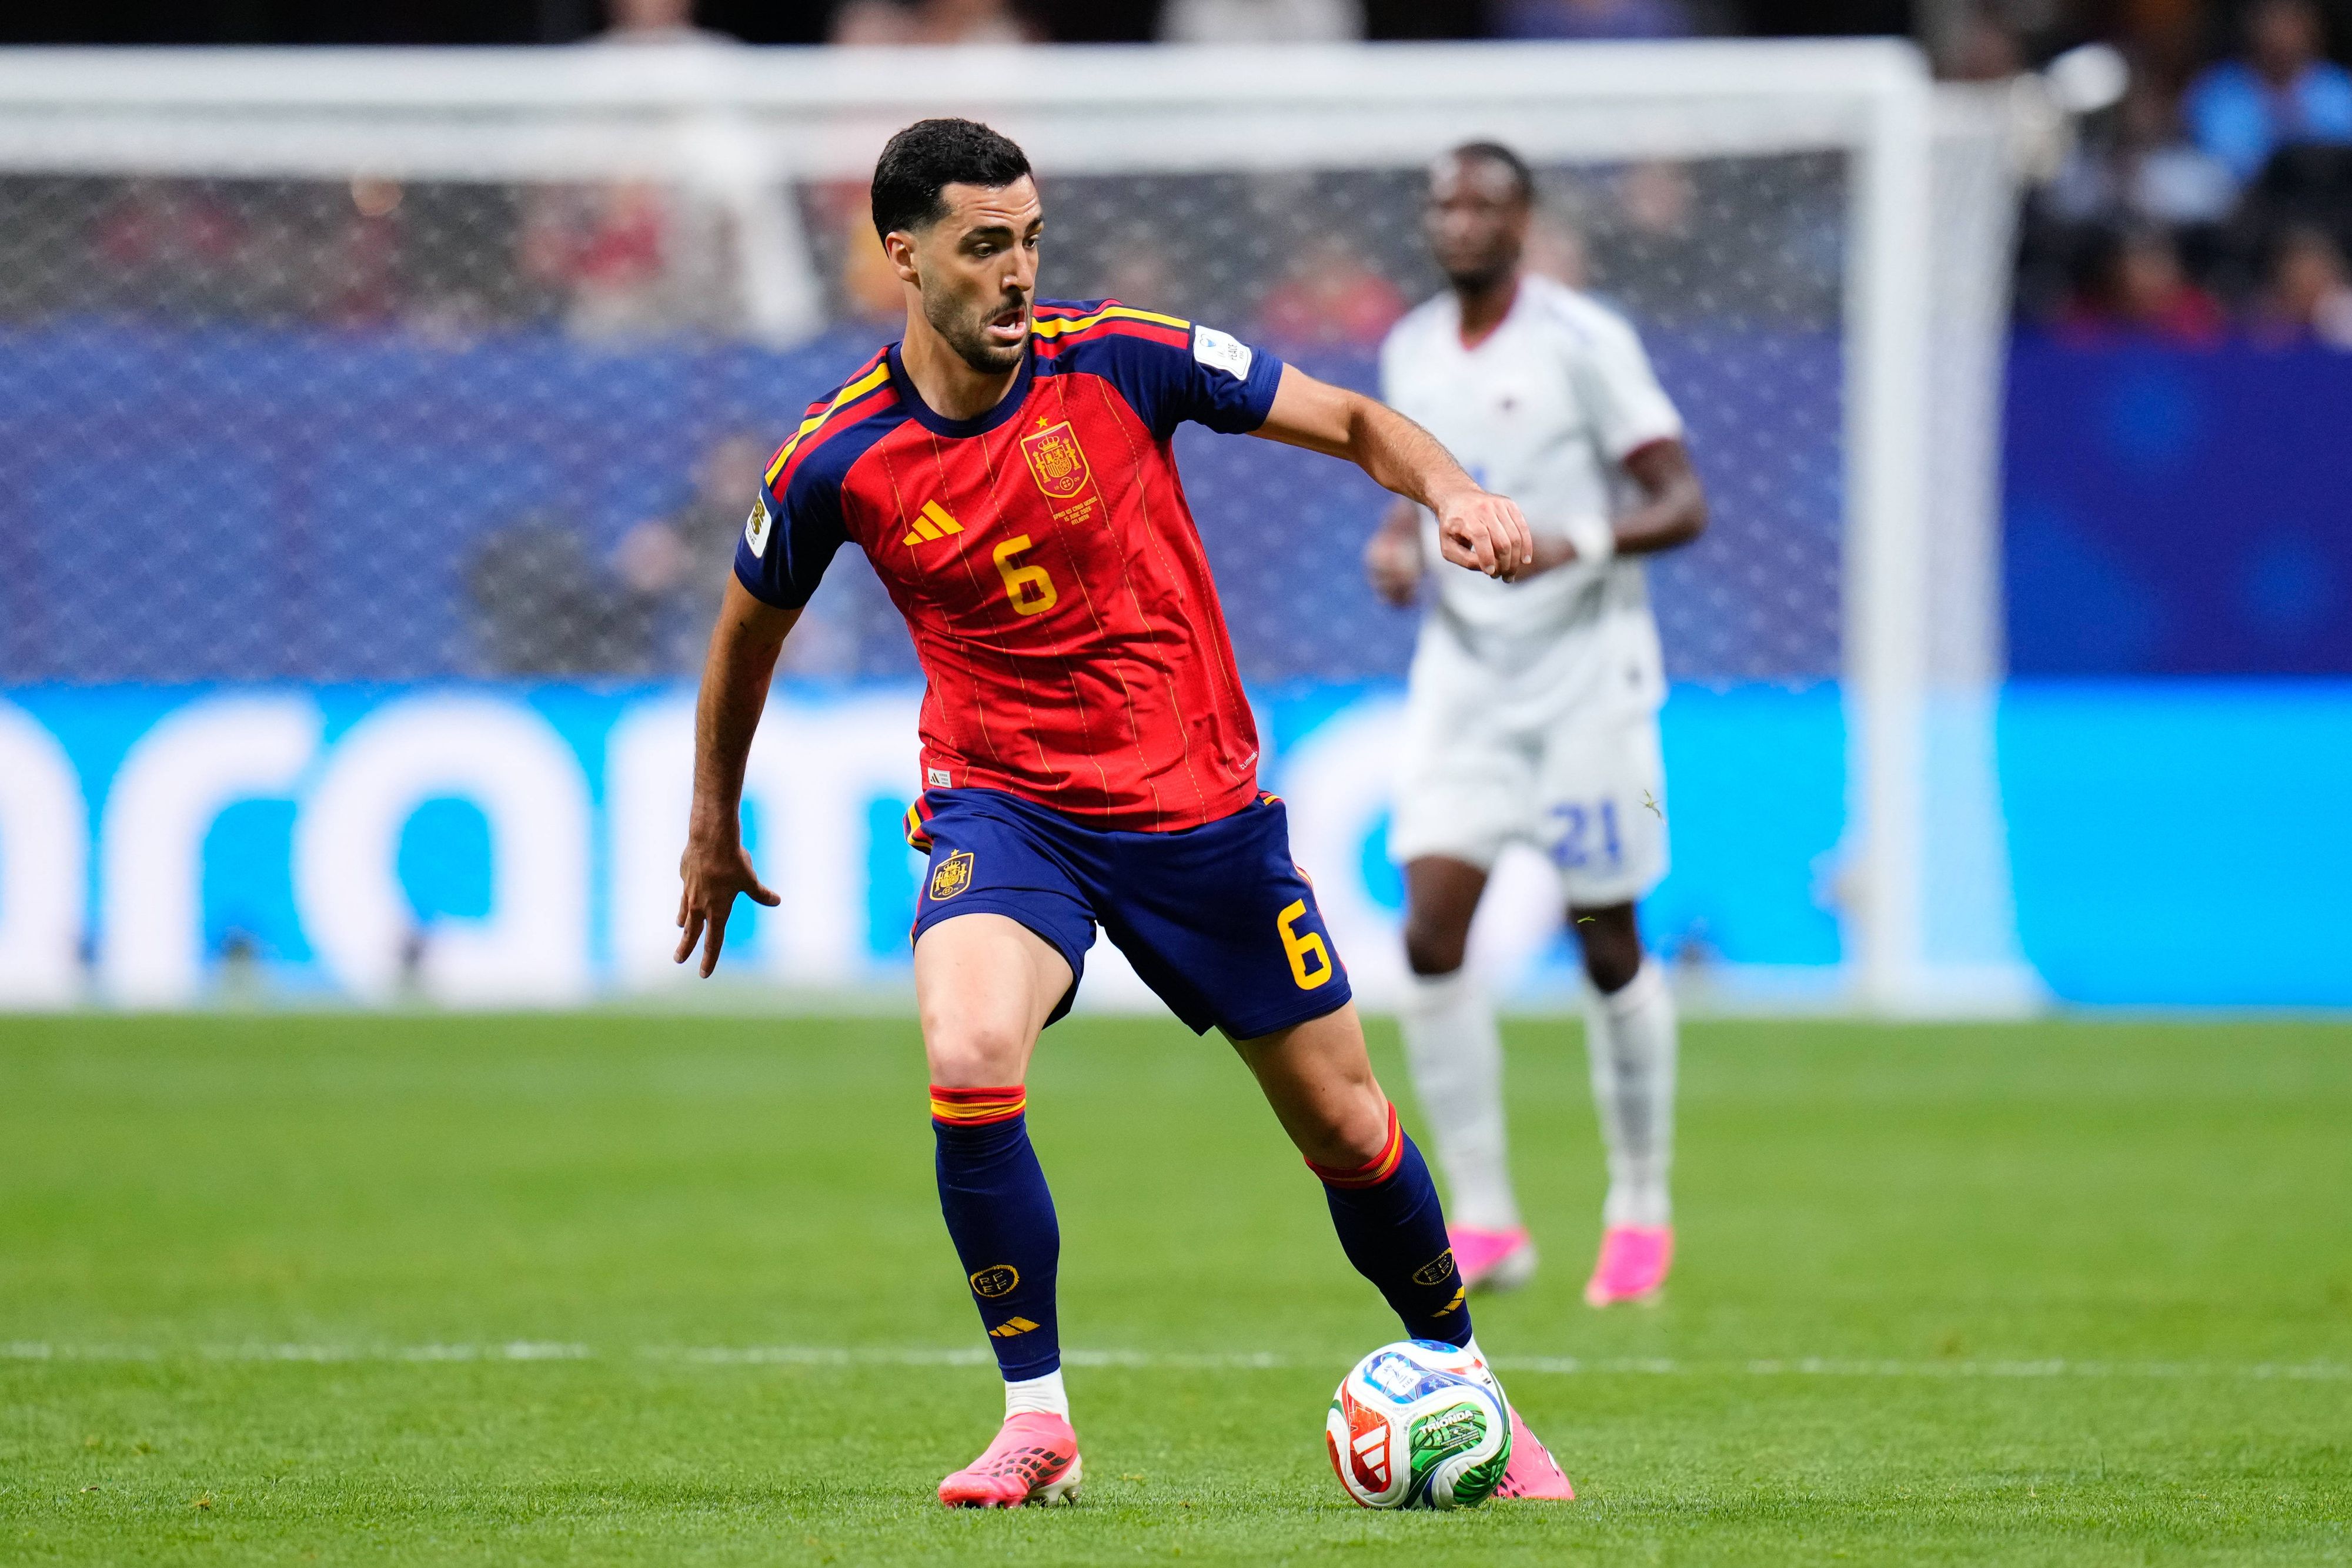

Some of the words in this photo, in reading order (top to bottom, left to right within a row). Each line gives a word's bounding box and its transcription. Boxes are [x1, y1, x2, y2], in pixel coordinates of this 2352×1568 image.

[1071, 513, 1090, 525] ATLANTA
[1080, 506, 1092, 514] 2026
[993, 534, 1057, 616] 6
[1546, 798, 1623, 869] 21
[1277, 898, 1332, 990] 6
[1402, 1378, 1414, 1388] FIFA
[1418, 1409, 1474, 1435] TRIONDA
